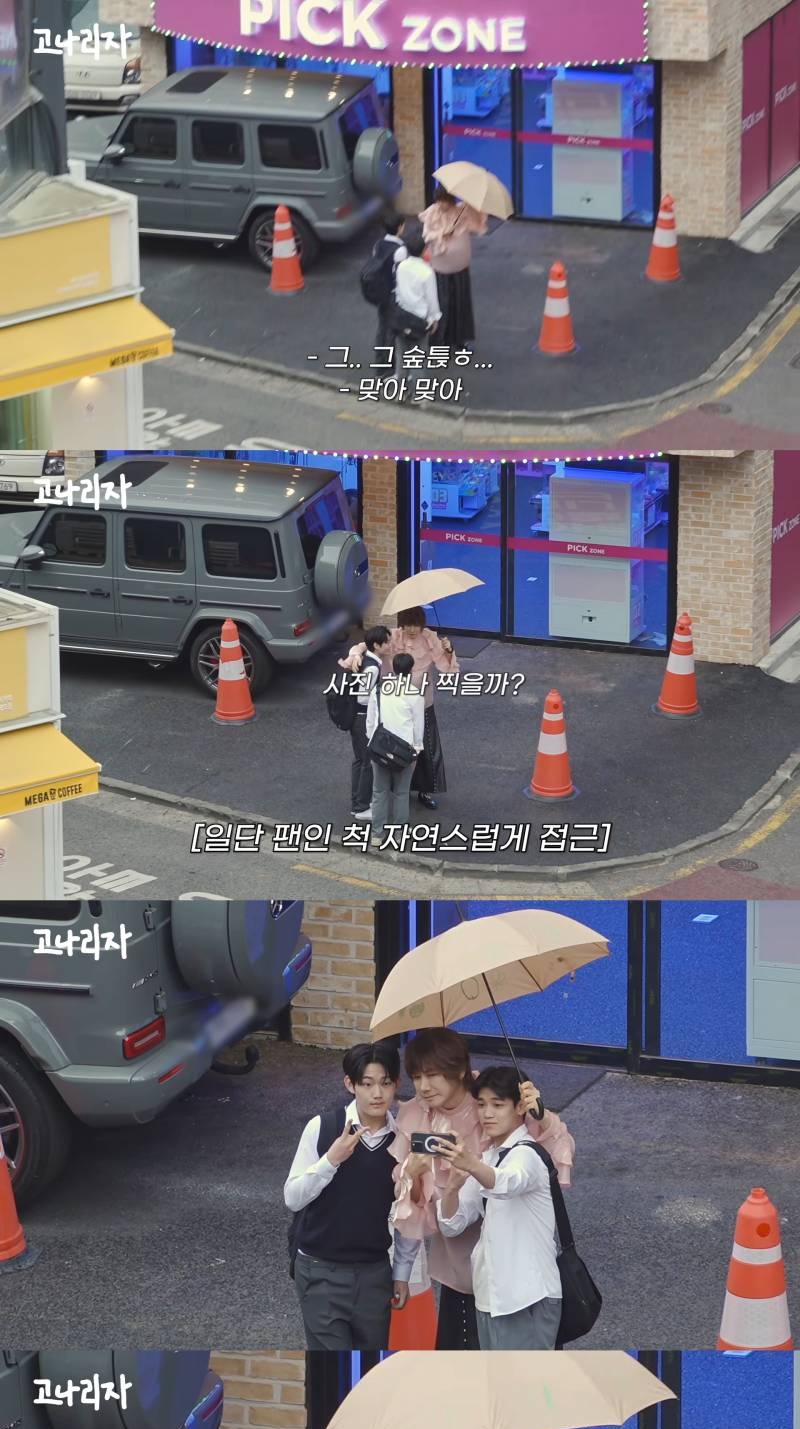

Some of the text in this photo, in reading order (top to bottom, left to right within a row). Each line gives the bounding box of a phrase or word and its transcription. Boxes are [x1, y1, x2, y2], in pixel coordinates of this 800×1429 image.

[240, 0, 527, 52] PICK ZONE
[445, 533, 466, 542] PICK
[567, 544, 605, 555] PICK ZONE
[24, 783, 82, 807] MEGA COFFEE
